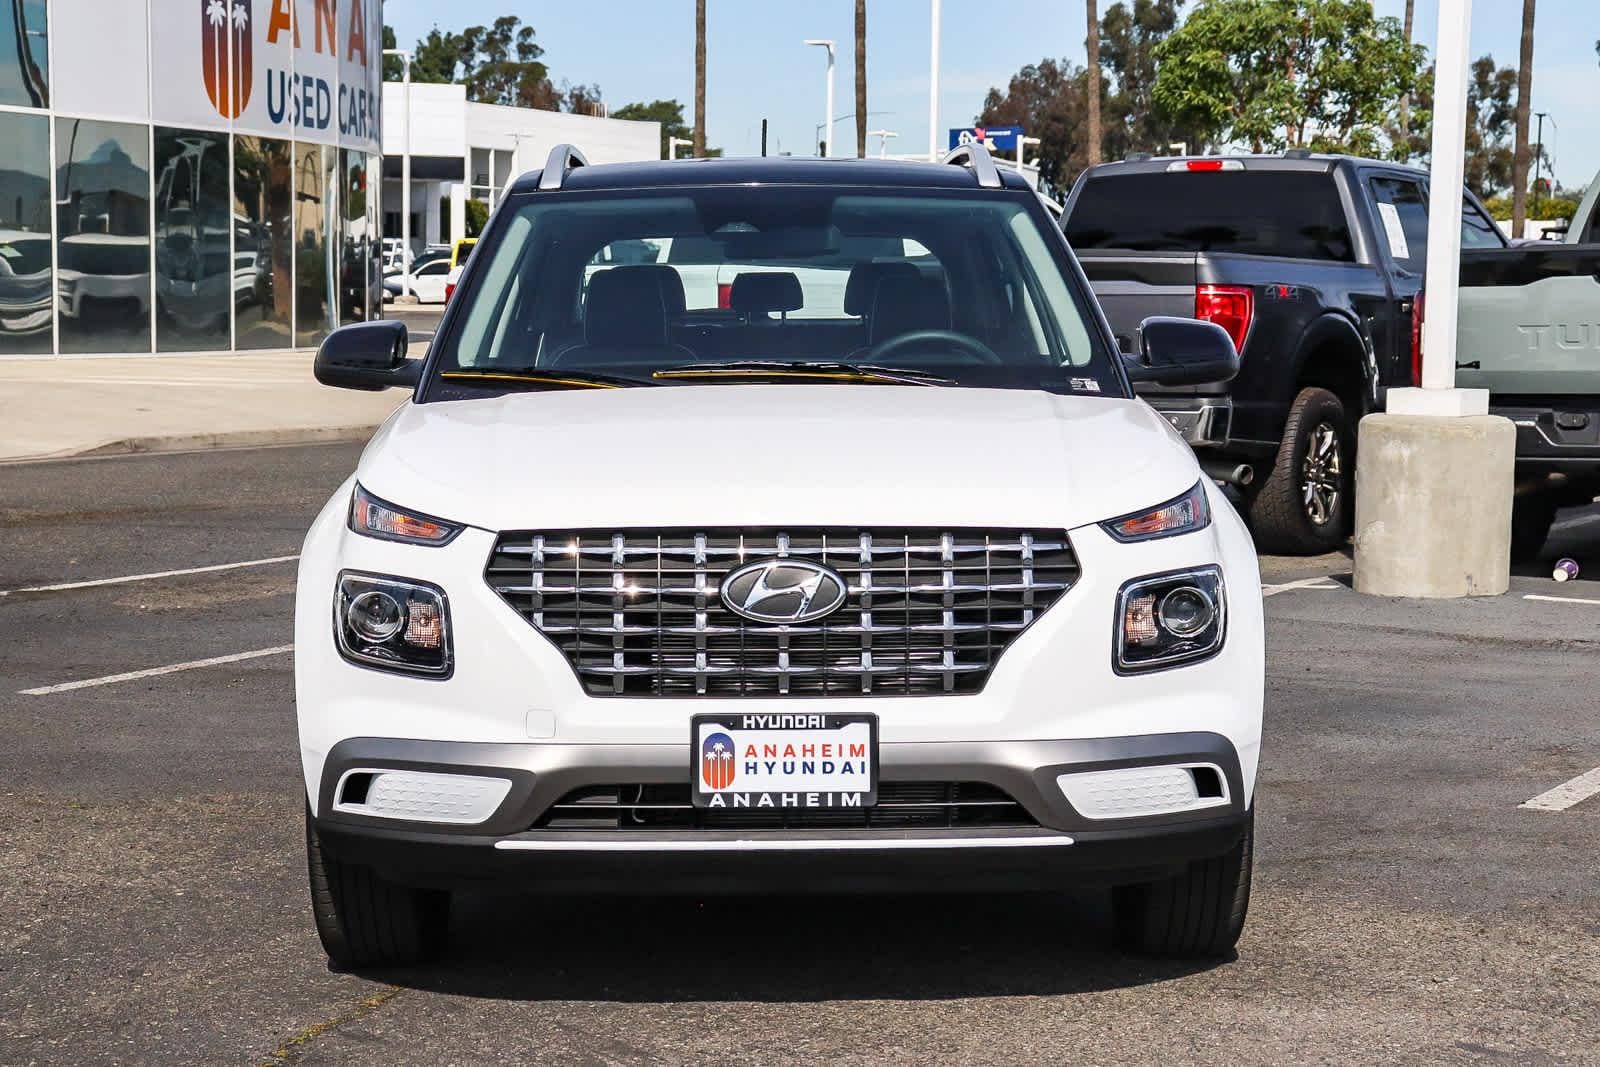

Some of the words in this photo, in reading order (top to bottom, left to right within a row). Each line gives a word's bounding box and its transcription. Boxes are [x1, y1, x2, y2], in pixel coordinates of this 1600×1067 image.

[266, 69, 331, 130] USED
[1517, 322, 1600, 350] TU
[743, 715, 826, 729] HYUNDAI
[744, 743, 866, 758] ANAHEIM
[744, 761, 866, 775] HYUNDAI
[708, 792, 862, 808] ANAHEIM
